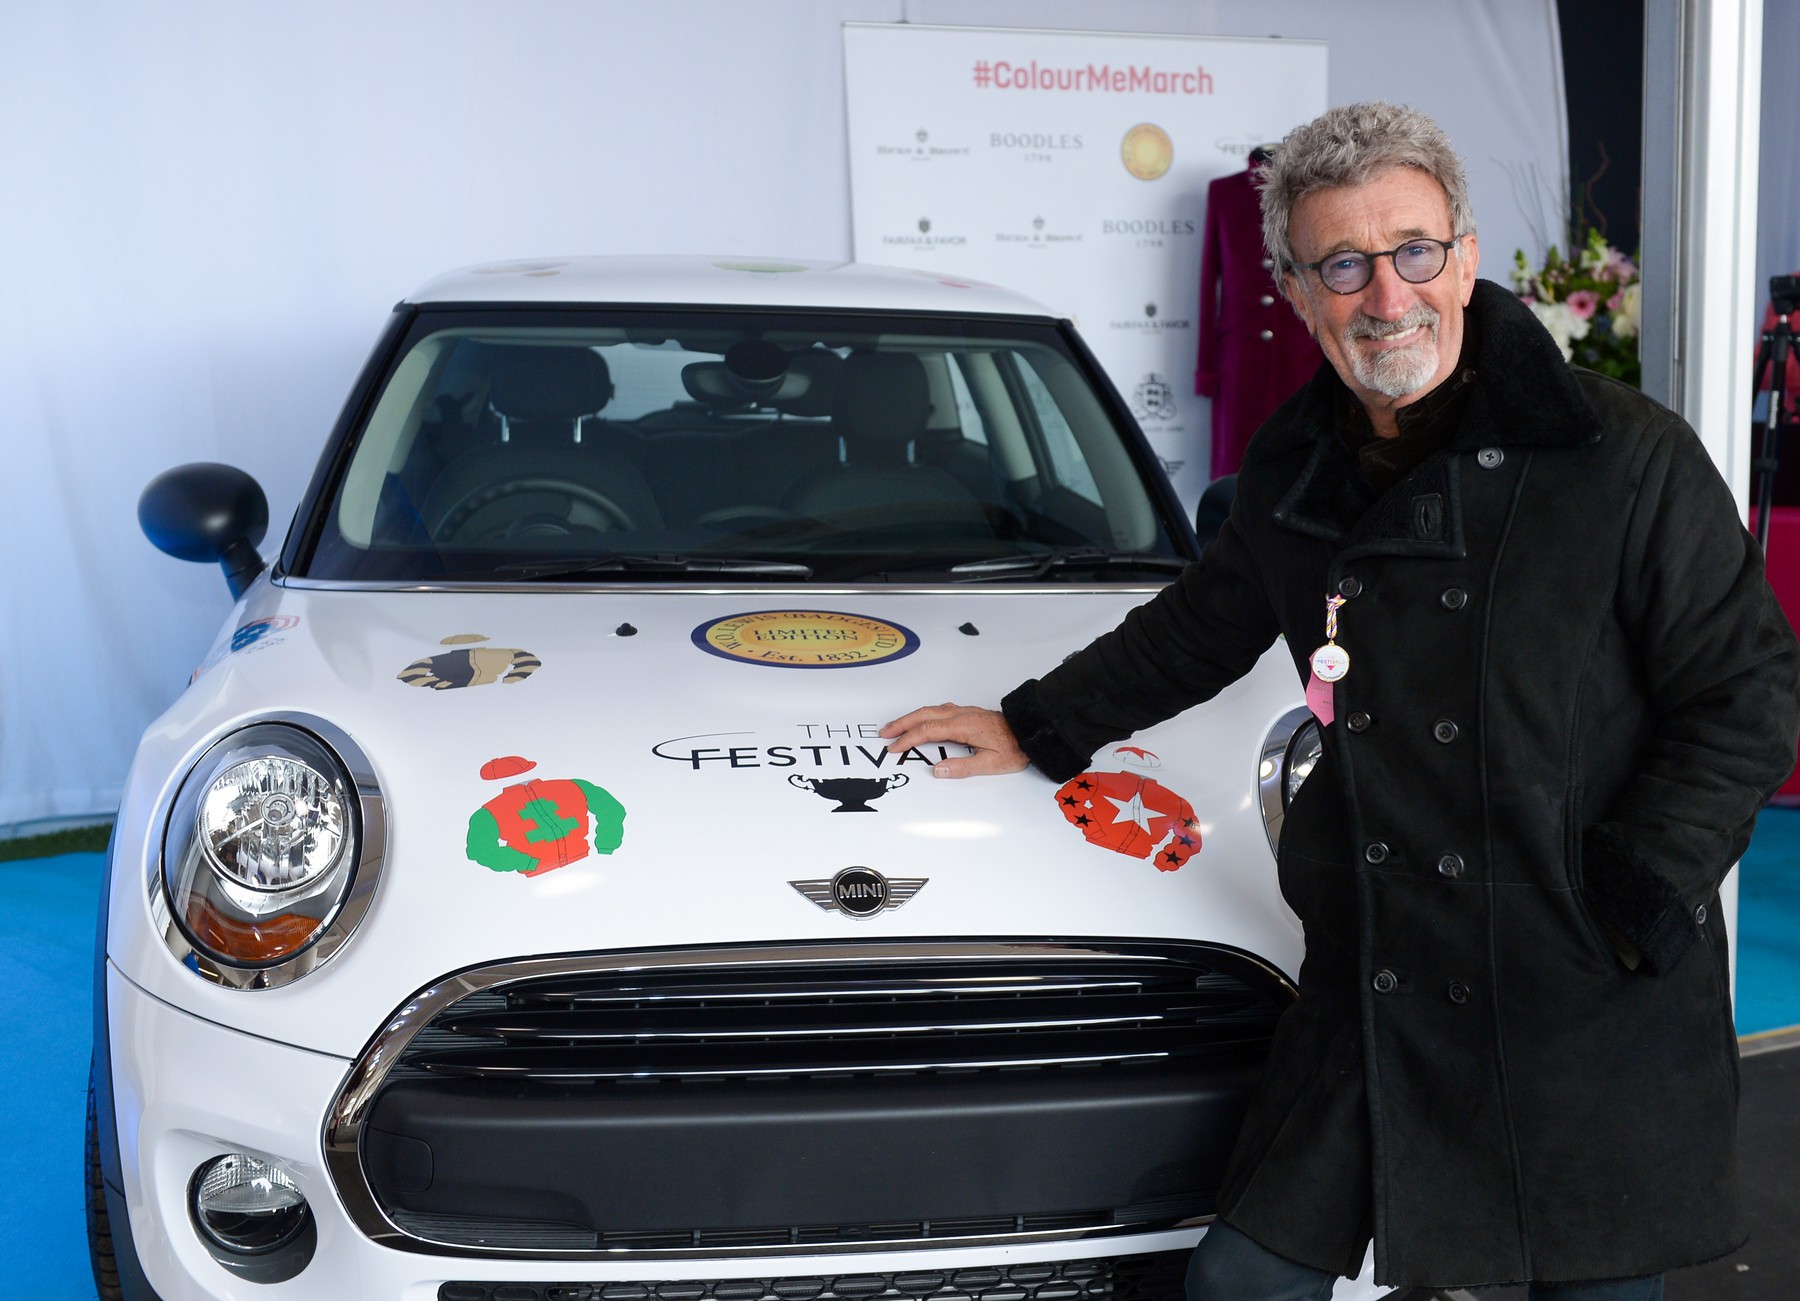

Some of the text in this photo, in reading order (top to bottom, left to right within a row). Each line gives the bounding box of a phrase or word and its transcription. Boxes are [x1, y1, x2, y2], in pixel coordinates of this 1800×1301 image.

[972, 60, 1214, 94] #ColourMeMarch
[989, 132, 1083, 149] BOODLES
[1102, 219, 1195, 235] BOODLES
[875, 633, 898, 648] LTD
[761, 650, 868, 662] Est. 1832
[796, 723, 882, 739] THE
[838, 883, 884, 899] MINI
